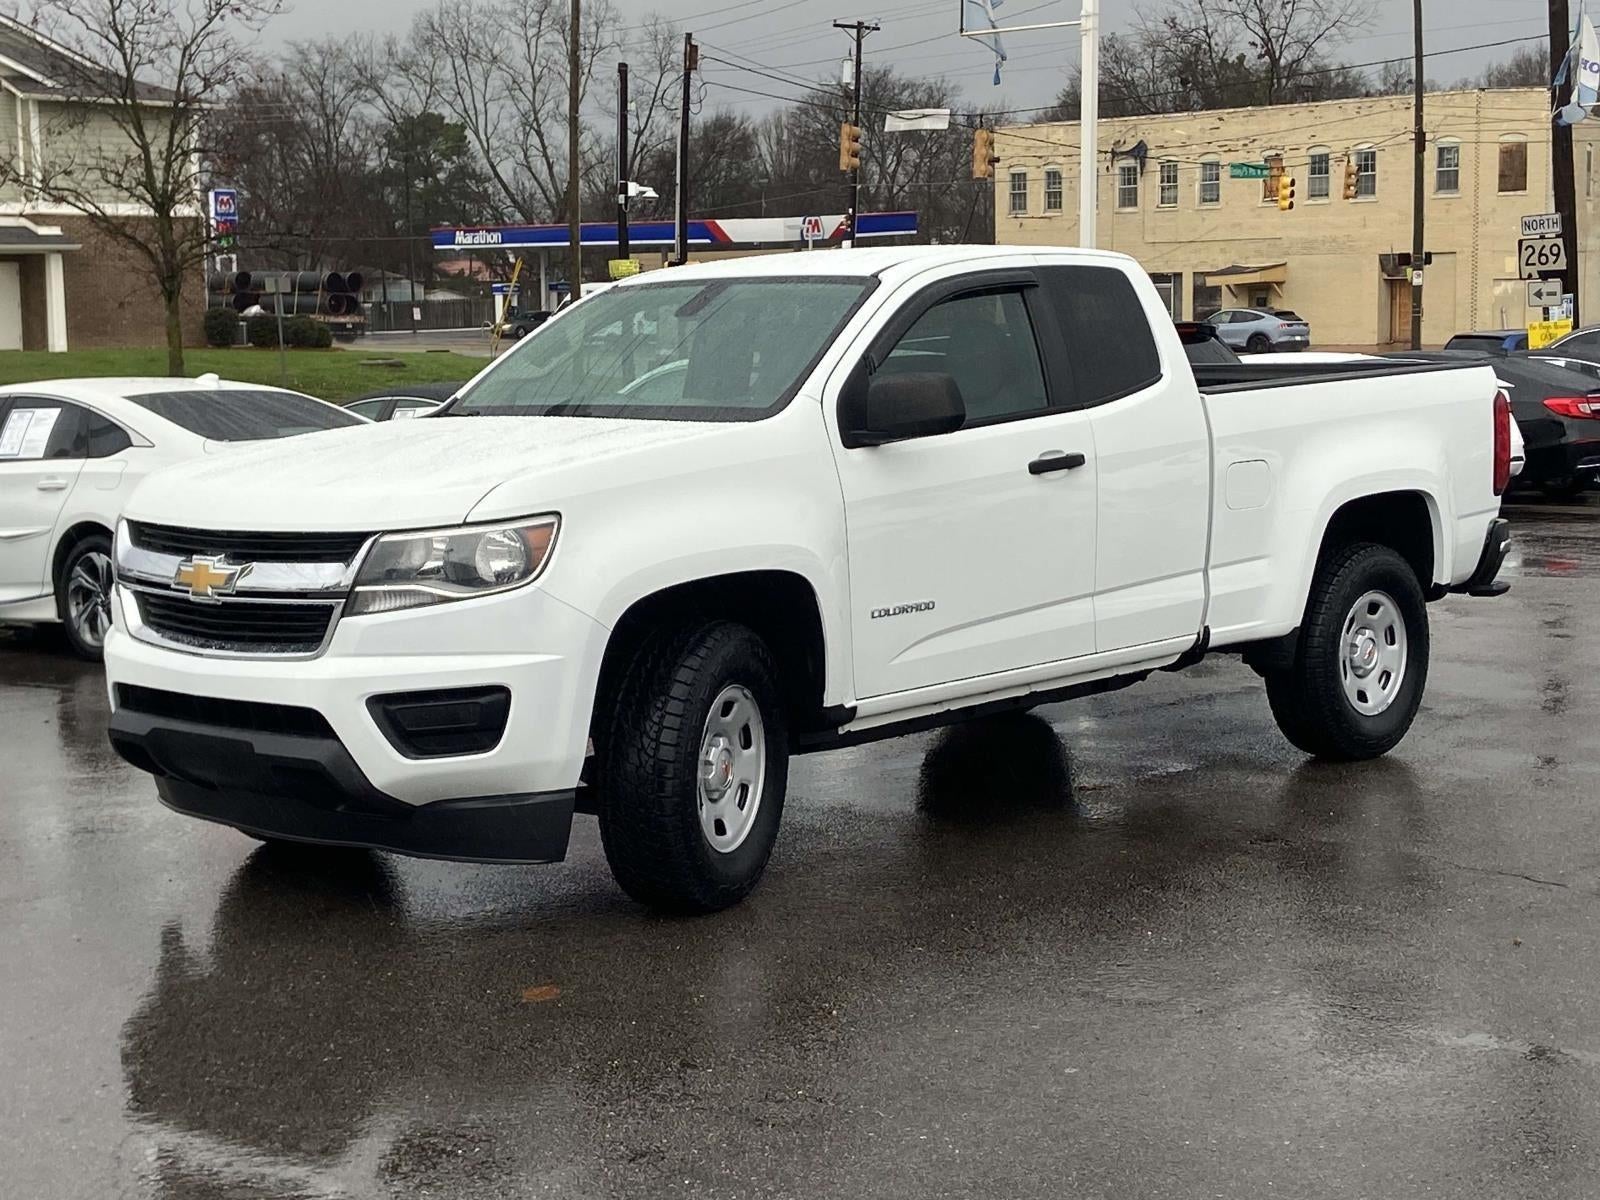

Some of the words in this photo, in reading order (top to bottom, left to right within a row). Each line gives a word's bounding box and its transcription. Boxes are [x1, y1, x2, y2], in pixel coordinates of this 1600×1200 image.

[1524, 217, 1559, 231] NORTH
[455, 230, 502, 244] Marathon
[1524, 243, 1561, 267] 269
[871, 600, 936, 619] COLORADO
